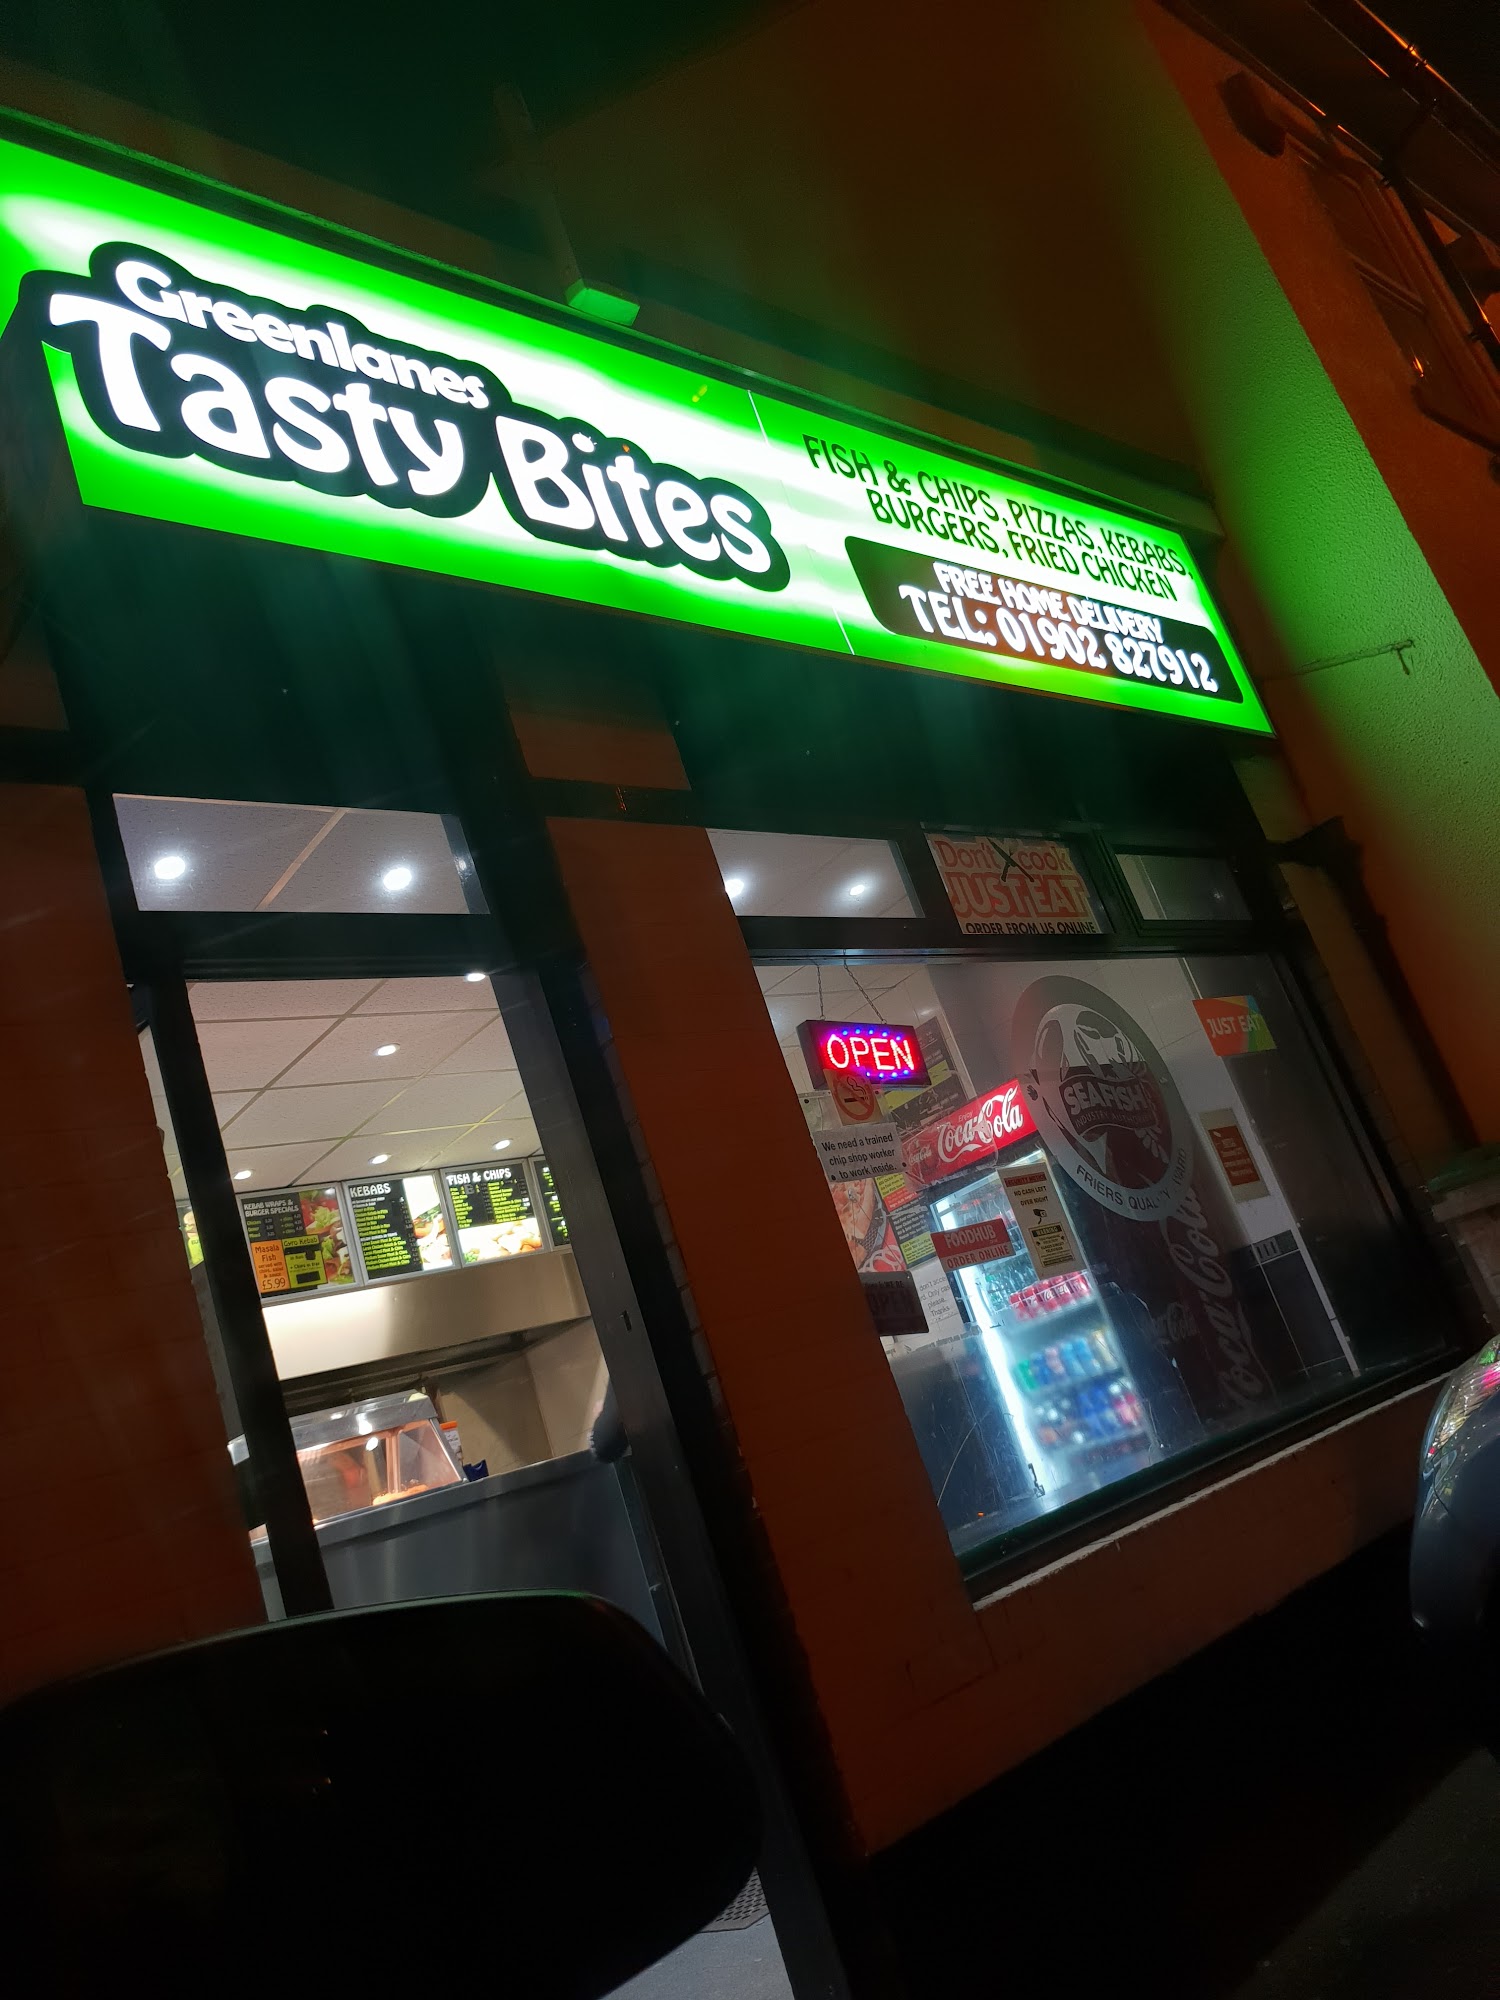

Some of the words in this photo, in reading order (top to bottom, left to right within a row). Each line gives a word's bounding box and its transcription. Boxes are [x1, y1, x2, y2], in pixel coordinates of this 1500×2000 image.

[114, 260, 490, 409] Greenlanes
[49, 293, 466, 496] Tasty
[495, 415, 773, 574] Bites
[802, 434, 878, 486] FISH
[886, 459, 912, 496] &
[917, 470, 1008, 527] CHIPS,
[1007, 498, 1104, 554] PIZZAS,
[1100, 527, 1195, 581] KEBABS,
[866, 488, 1009, 559] BURGERS,
[1011, 530, 1081, 576] FRIED
[1081, 551, 1178, 602] CHICKEN
[933, 561, 999, 604] FREE
[999, 578, 1072, 621] HOME
[1068, 596, 1165, 644] DELIVERY
[898, 585, 998, 647] TEL:
[996, 607, 1108, 669] 01902
[1105, 632, 1219, 693] 827912
[935, 840, 1001, 870] Don't
[1017, 846, 1073, 871] cook
[948, 875, 1028, 915] JUST
[1026, 876, 1087, 914] EAT
[966, 922, 1003, 934] ORDER
[1006, 922, 1038, 934] FROM
[1039, 922, 1055, 934] US
[1057, 921, 1097, 934] ONLINE
[1206, 1016, 1237, 1039] JUST
[1238, 1014, 1262, 1033] EAT
[826, 1034, 915, 1071] OPEN
[1063, 1081, 1150, 1116] SEAFISH
[937, 1085, 1024, 1163] Coca-Cola
[821, 1142, 836, 1152] We
[837, 1138, 858, 1150] need
[866, 1132, 893, 1145] trained
[829, 1154, 848, 1168] chip
[848, 1152, 869, 1165] shop
[868, 1148, 895, 1160] worker
[446, 1173, 471, 1186] FISH
[472, 1172, 481, 1182] &
[483, 1168, 512, 1181] CHIPS
[839, 1169, 849, 1180] to
[849, 1167, 870, 1178] work
[871, 1162, 897, 1174] inside.
[349, 1182, 391, 1197] KEBABS
[1022, 1187, 1035, 1195] CASH
[1035, 1185, 1047, 1193] LEFT
[1076, 1164, 1123, 1206] FRIERS
[1129, 1187, 1171, 1210] QUALY
[243, 1201, 264, 1210] KEBAB
[265, 1199, 286, 1209] WRAPS
[1020, 1198, 1034, 1206] OVER
[1034, 1195, 1049, 1204] NIGHT
[244, 1208, 270, 1217] BURGER
[270, 1205, 300, 1214] SPECIALS
[299, 1237, 318, 1245] Kebab
[943, 1224, 997, 1249] FOODHUB
[255, 1244, 280, 1253] Masala
[261, 1254, 277, 1262] Fish
[947, 1253, 978, 1269] ORDER
[979, 1244, 1010, 1260] ONLINE
[262, 1277, 286, 1290] £5.99
[927, 1288, 941, 1299] Only
[926, 1296, 945, 1310] please
[930, 1304, 951, 1317] Thanks
